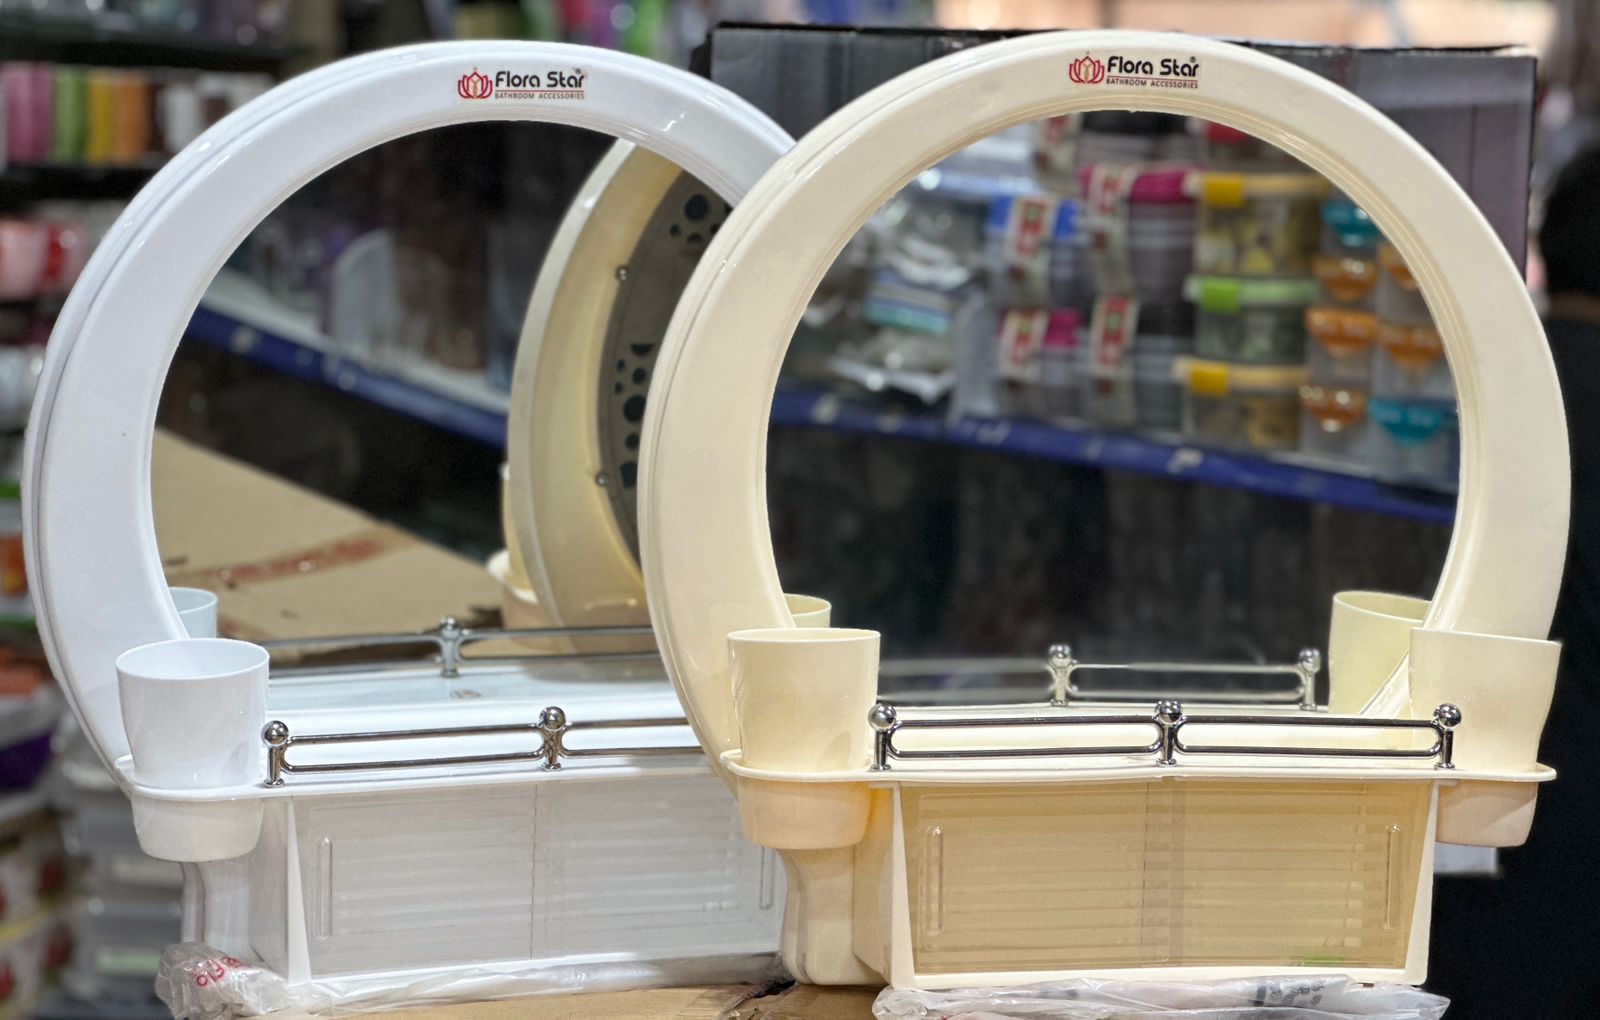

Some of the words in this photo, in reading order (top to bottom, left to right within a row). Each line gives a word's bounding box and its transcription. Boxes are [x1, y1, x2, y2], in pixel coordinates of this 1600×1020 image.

[1107, 56, 1153, 74] Flora
[495, 70, 541, 88] Flora
[1106, 78, 1147, 86] BATHROOM
[1150, 79, 1198, 89] ACCESSORIES
[495, 92, 535, 100] BATHROOM
[539, 92, 585, 100] ACCESSORIES
